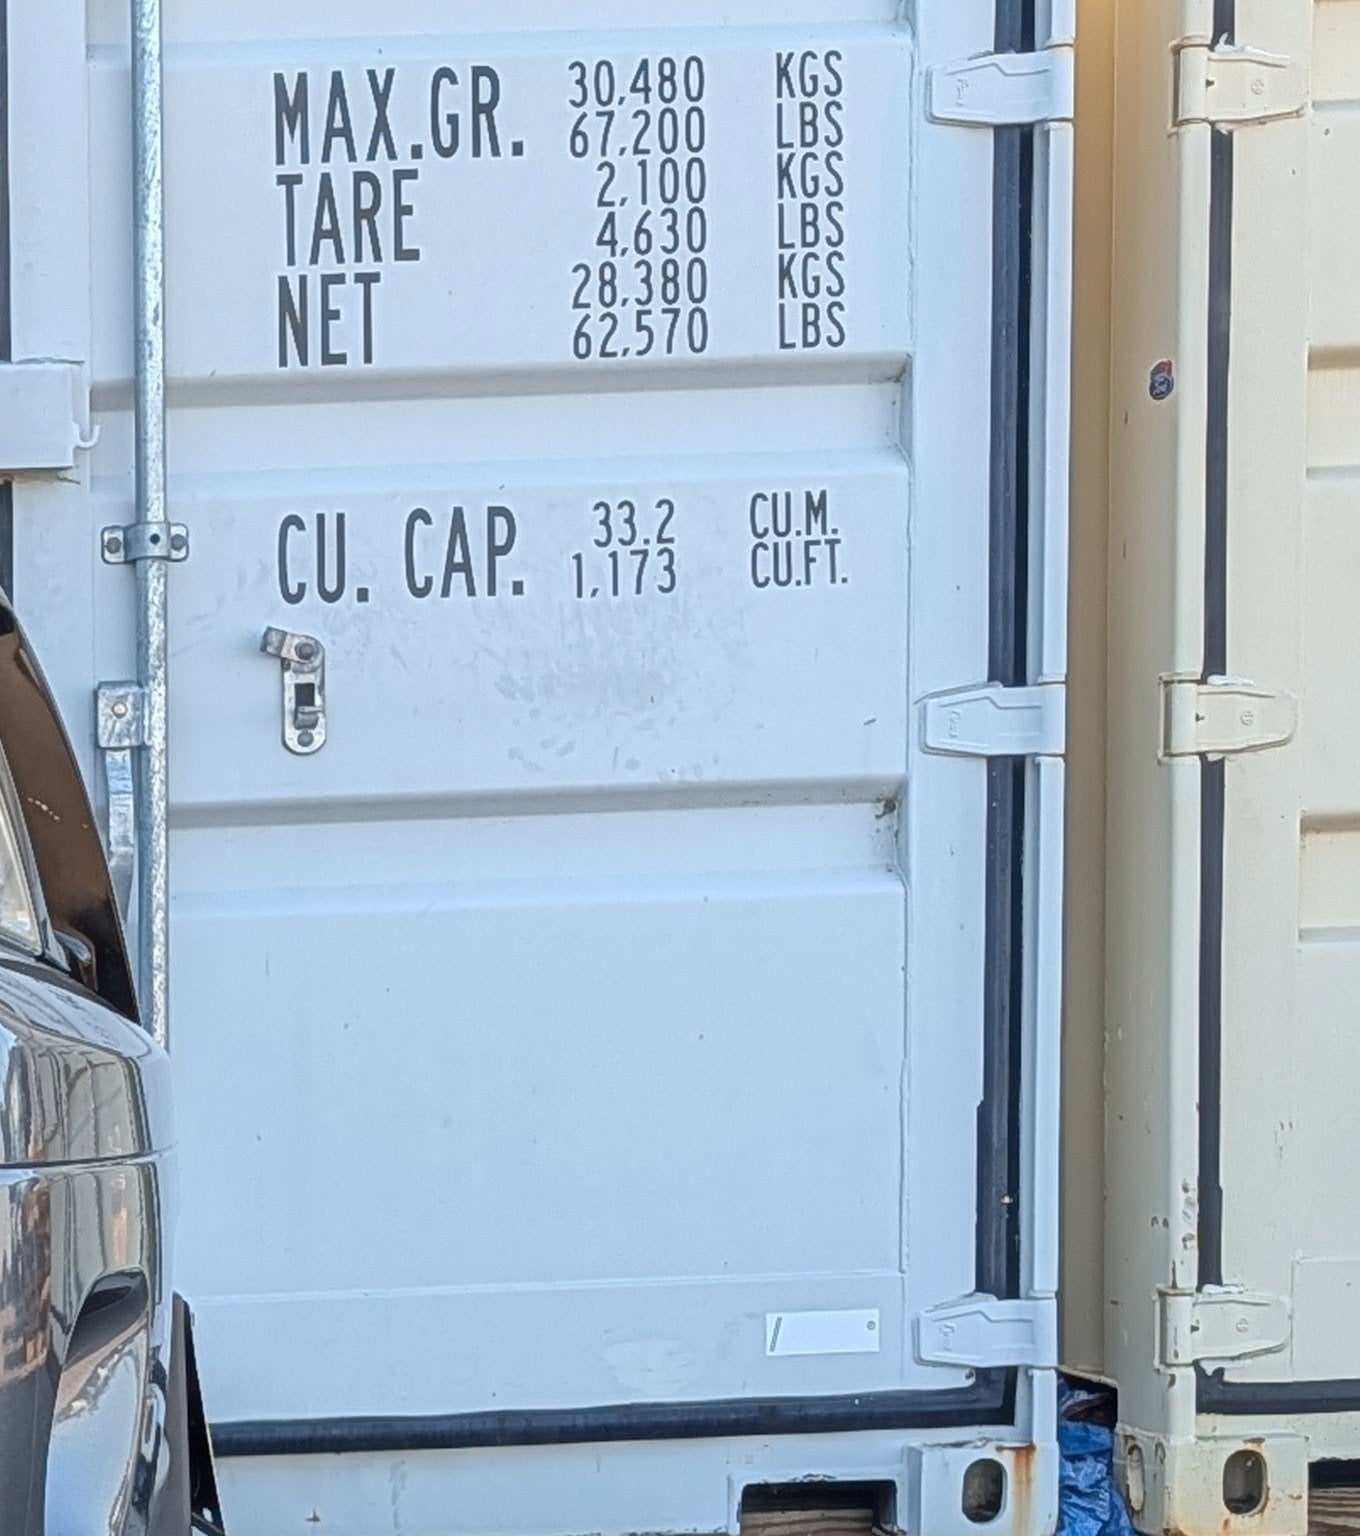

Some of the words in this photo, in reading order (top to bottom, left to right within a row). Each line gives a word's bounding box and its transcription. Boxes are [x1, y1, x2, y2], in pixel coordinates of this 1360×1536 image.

[568, 55, 705, 108] 30,480
[776, 50, 843, 98] KGS
[274, 65, 525, 166] MAX.GR.
[569, 106, 706, 158] 67,200
[776, 101, 844, 149] LBS
[596, 157, 707, 208] 2,100
[777, 151, 844, 199] KGS
[276, 168, 421, 266] TARE
[595, 206, 707, 257] 4,630
[778, 201, 845, 249] LBS
[571, 256, 708, 310] 28,380
[779, 251, 846, 299] KGS
[277, 271, 382, 368] NET
[573, 306, 709, 360] 62,570
[779, 301, 846, 349] LBS
[592, 498, 676, 548] 33.2
[749, 489, 840, 540] CU.M.
[278, 512, 370, 605] CU.
[404, 505, 525, 599] CAP.
[572, 547, 677, 600] 1,173
[751, 537, 849, 589] CU.FT.
